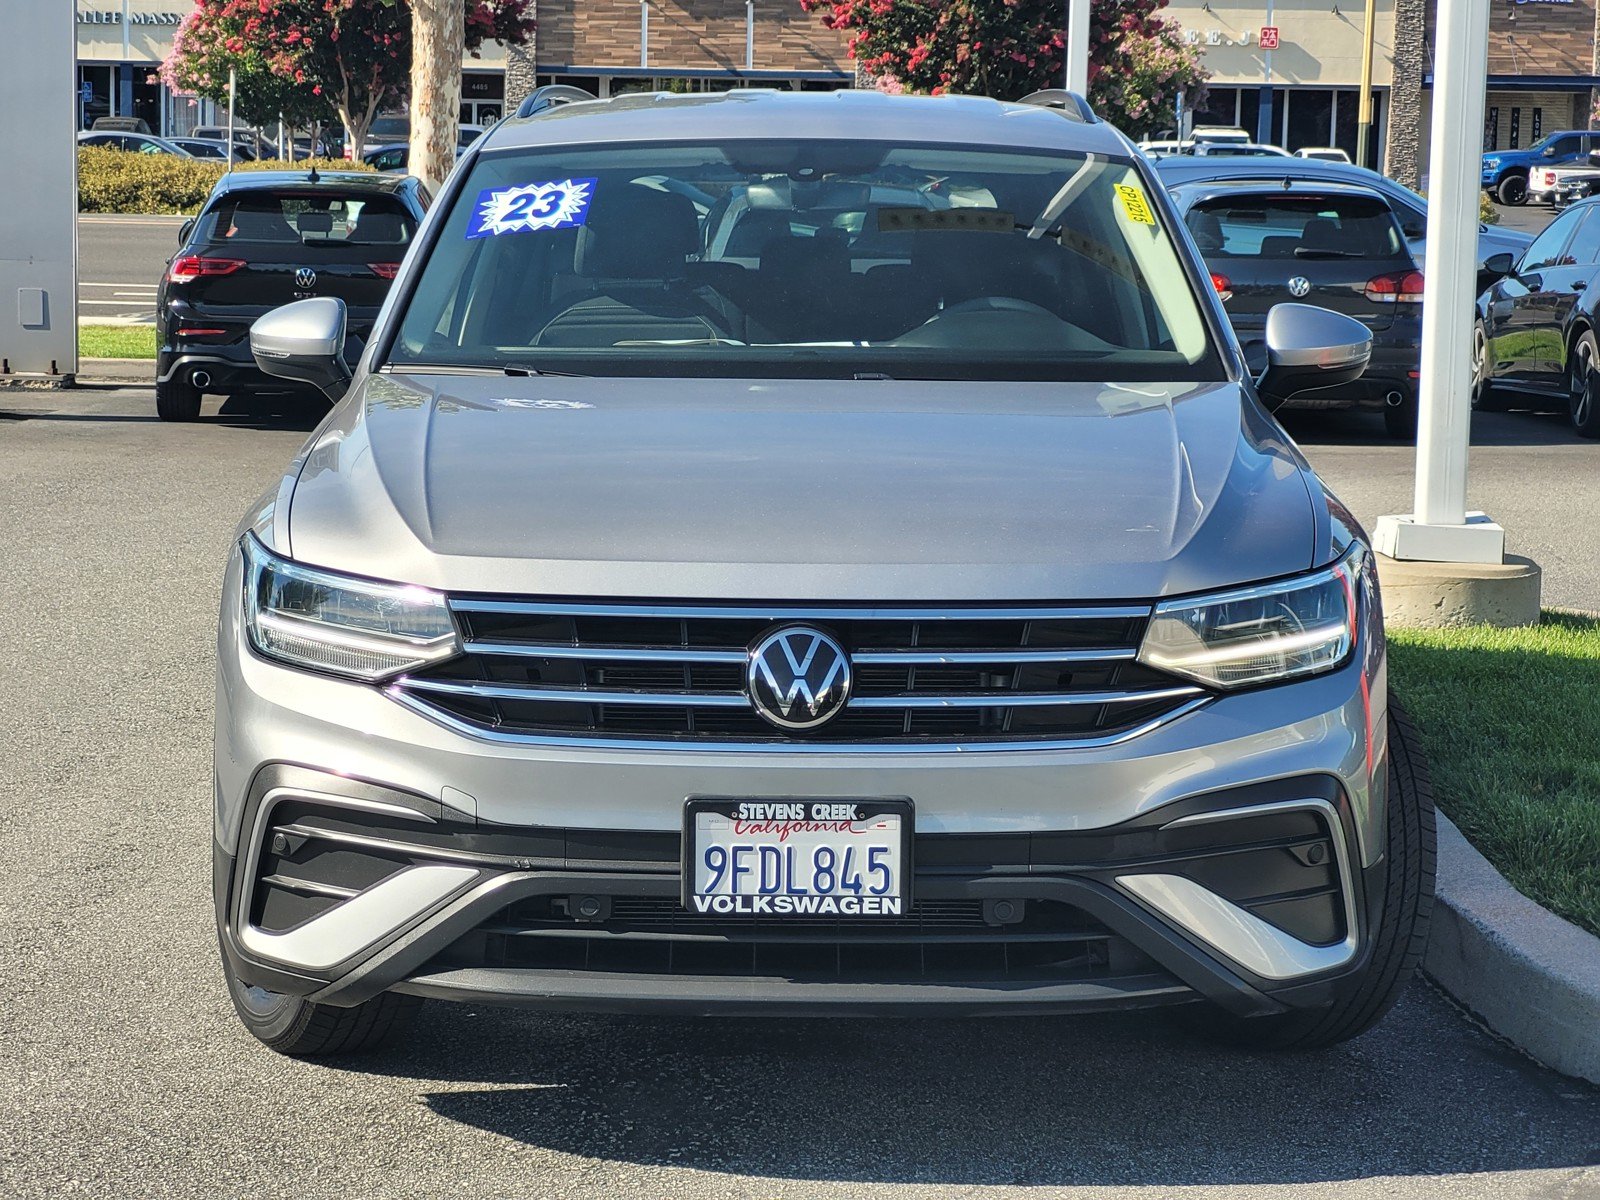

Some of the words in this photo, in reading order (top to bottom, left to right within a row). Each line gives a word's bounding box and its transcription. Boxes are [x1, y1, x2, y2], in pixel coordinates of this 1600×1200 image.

[500, 190, 565, 222] 23
[1120, 186, 1148, 222] CP12215
[750, 628, 850, 728] VW
[738, 803, 805, 820] STEVENS
[811, 804, 858, 820] CREEK
[734, 820, 867, 842] California
[704, 845, 890, 895] 9FDL845
[693, 895, 901, 914] VOLKSWAGEN
